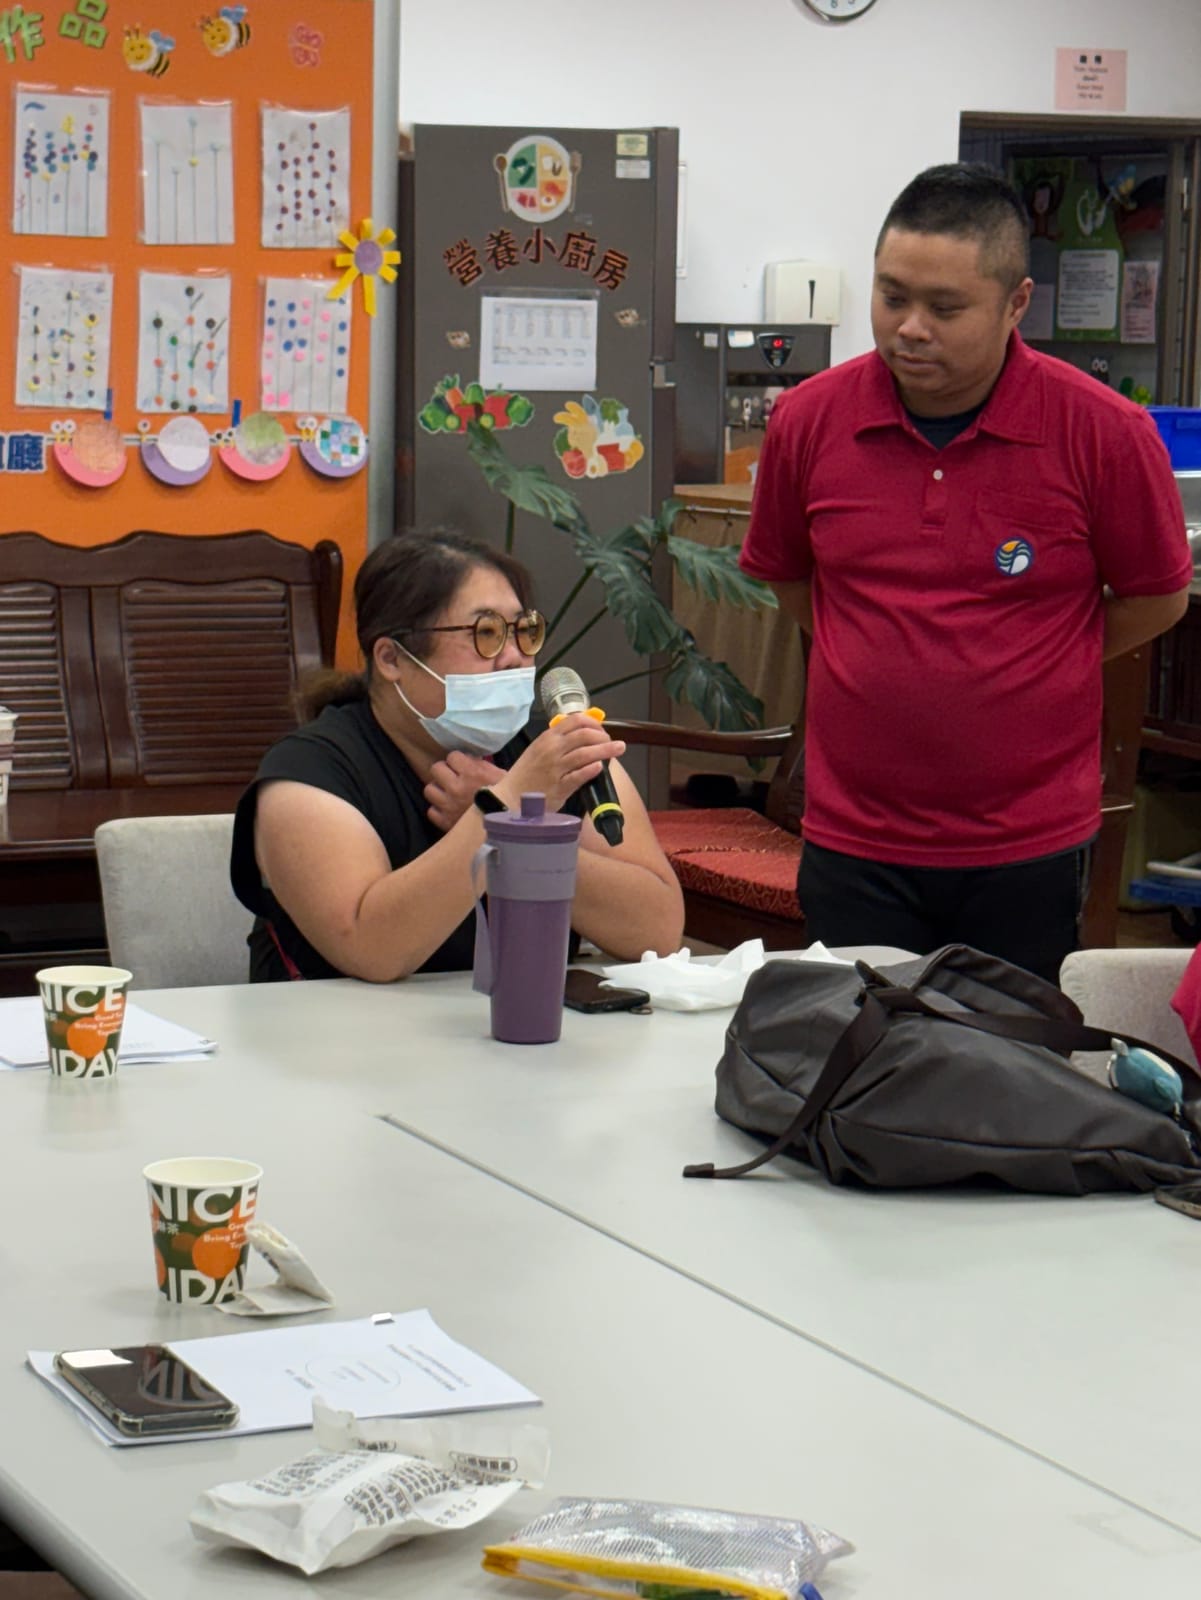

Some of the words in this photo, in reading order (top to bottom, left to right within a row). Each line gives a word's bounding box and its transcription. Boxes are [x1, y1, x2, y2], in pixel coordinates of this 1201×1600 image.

[443, 227, 630, 291] 營養小廚房
[41, 982, 123, 1014] NICE
[149, 1178, 257, 1223] NICE
